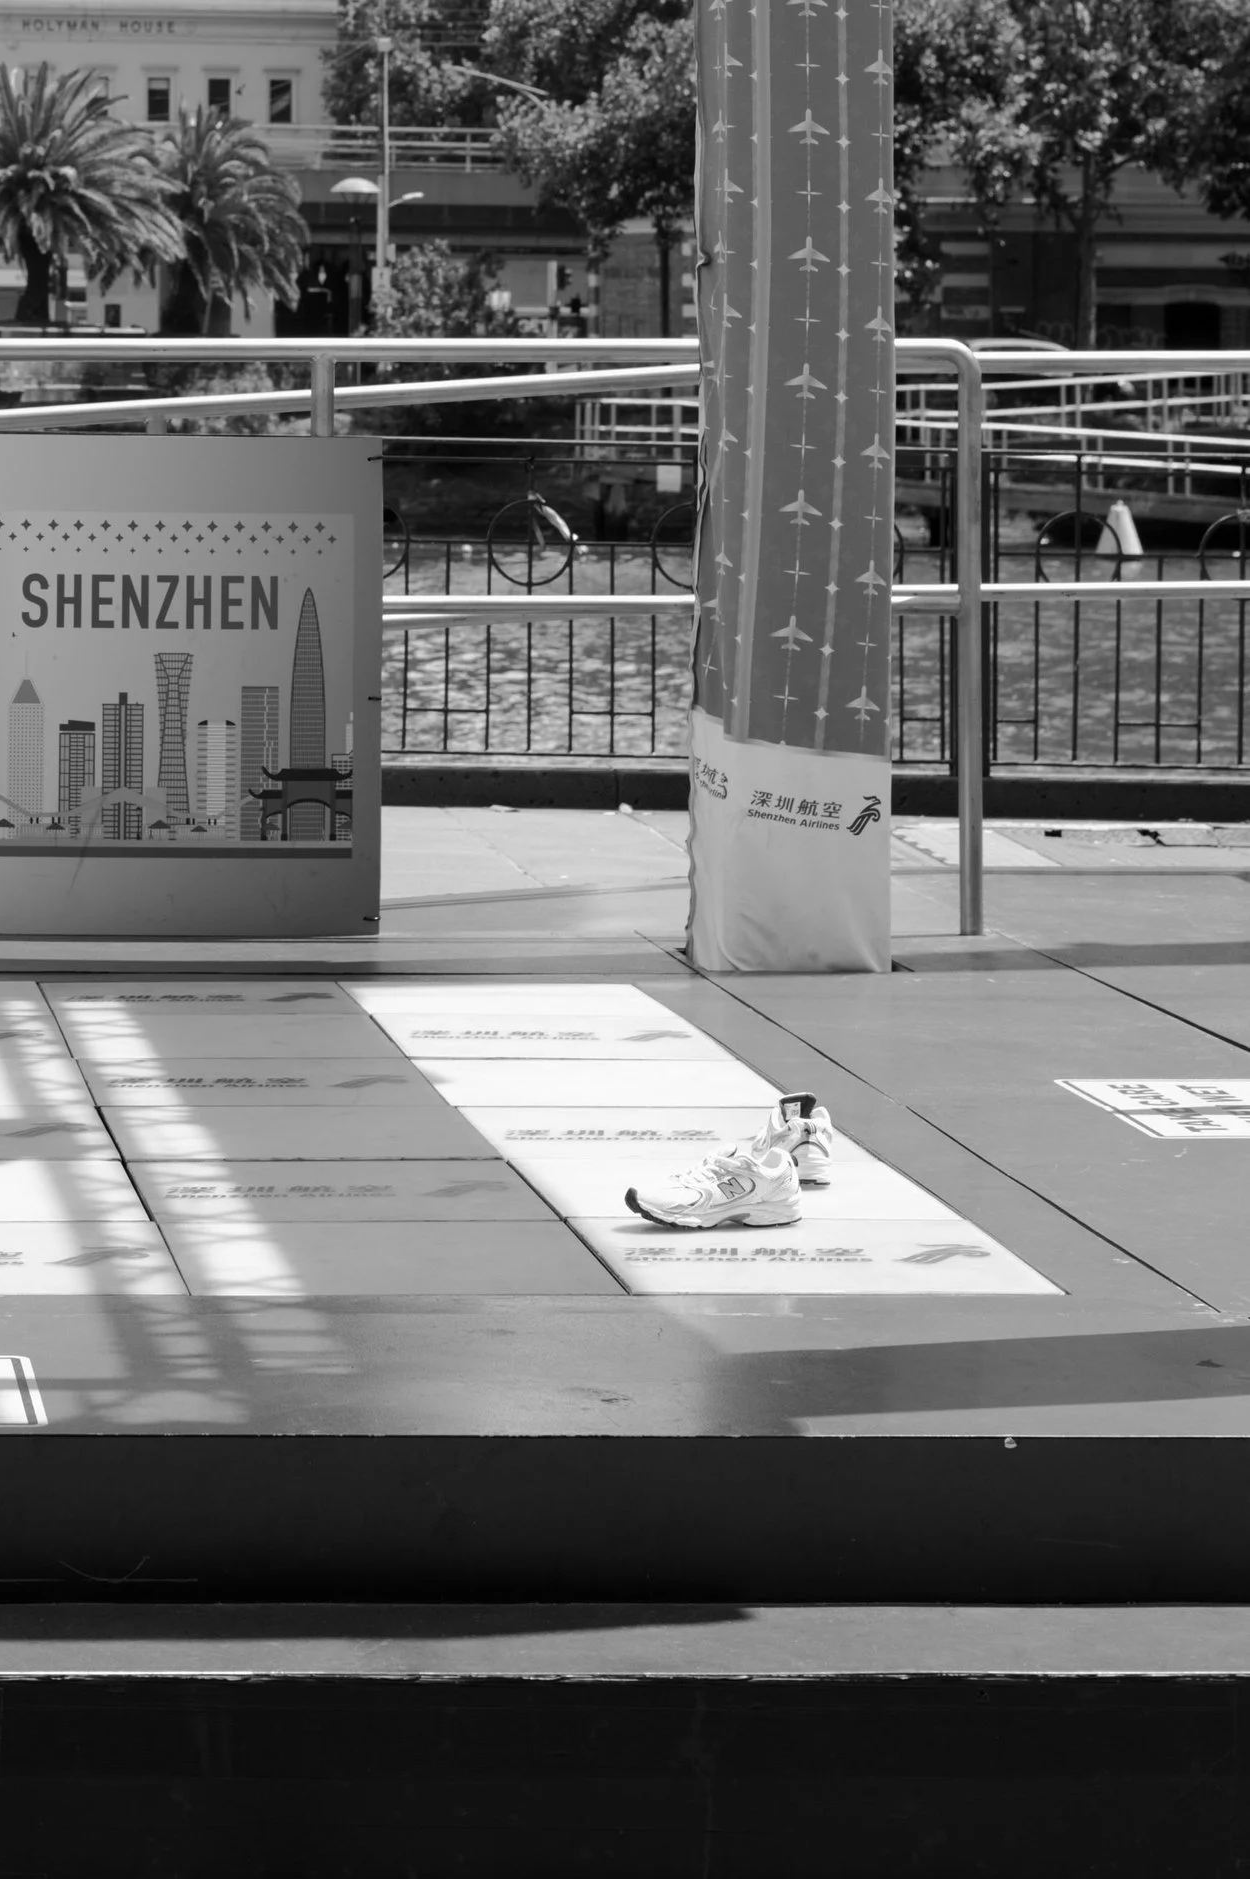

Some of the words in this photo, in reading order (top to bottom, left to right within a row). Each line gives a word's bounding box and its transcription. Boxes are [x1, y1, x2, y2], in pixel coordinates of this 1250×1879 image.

[22, 19, 100, 33] HOLYMAN
[119, 20, 176, 34] HOUSE
[21, 572, 280, 630] SHENZHEN
[750, 789, 843, 820] 深圳航空
[747, 808, 796, 825] Shenzhen
[799, 819, 841, 831] Airlines
[1107, 1084, 1180, 1106] CARE
[1152, 1108, 1229, 1133] TAKE
[717, 1176, 746, 1200] N
